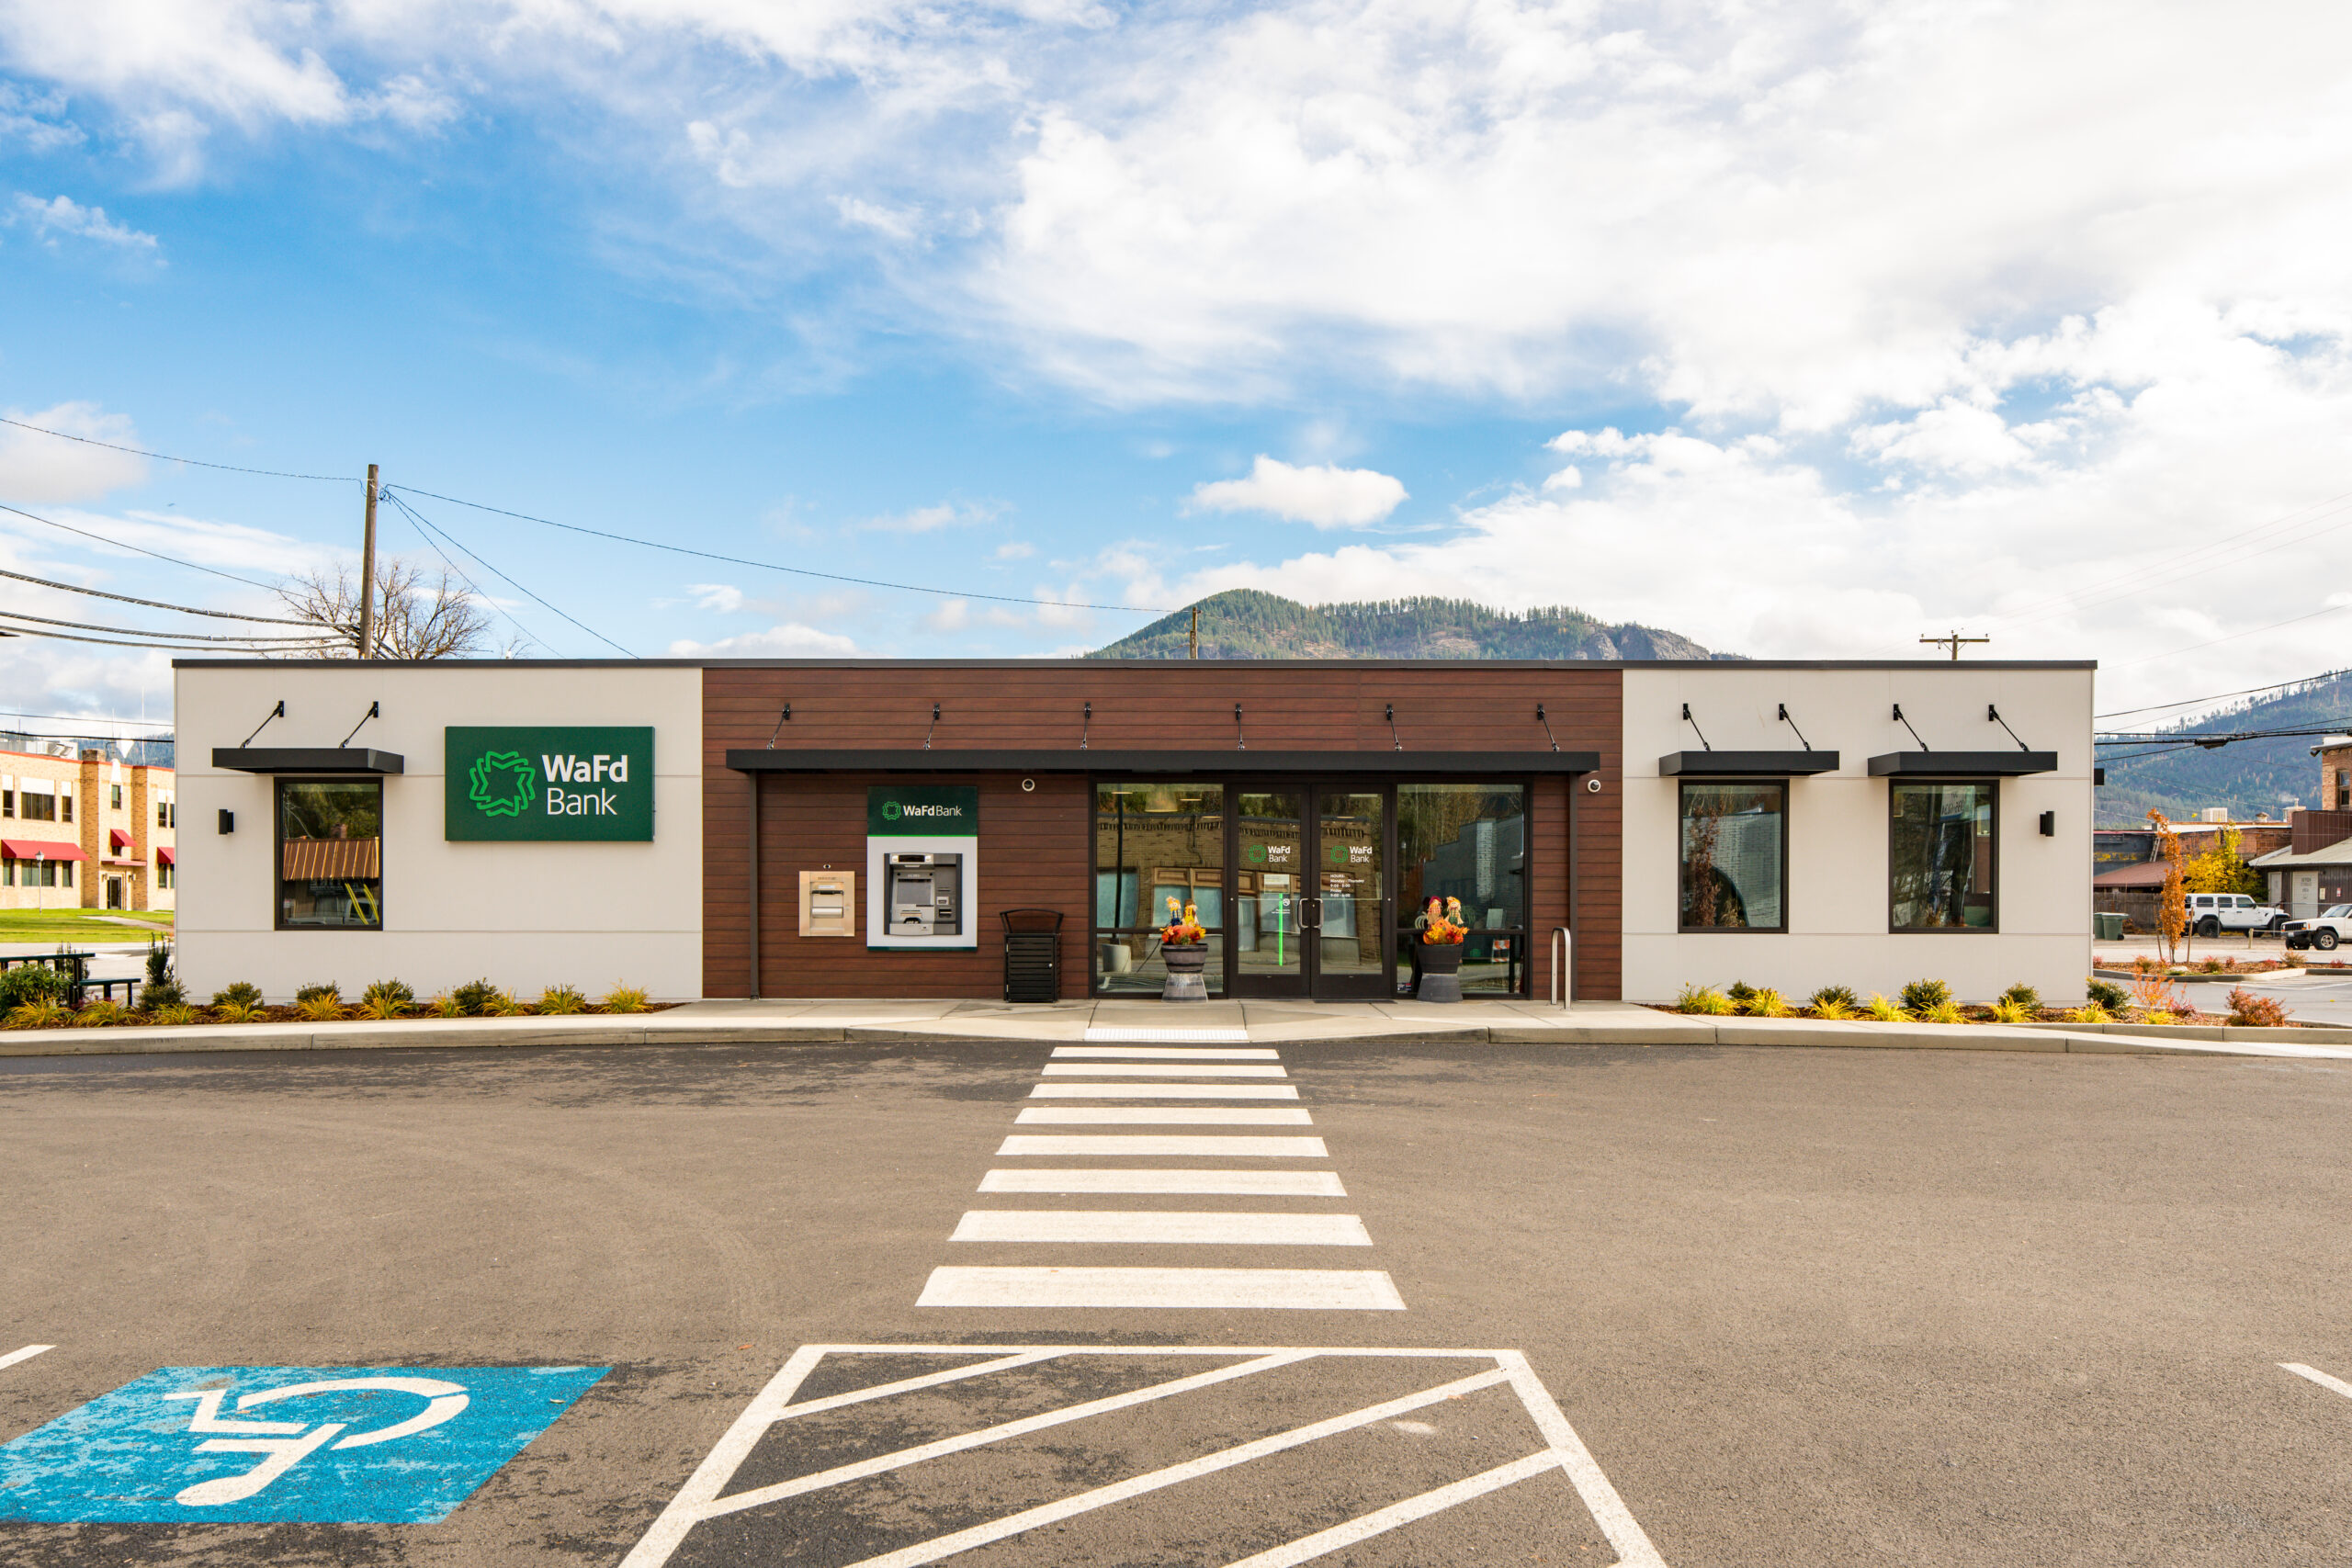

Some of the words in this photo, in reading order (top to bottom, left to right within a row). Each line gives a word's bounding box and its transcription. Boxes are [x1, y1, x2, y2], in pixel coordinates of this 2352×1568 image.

[541, 754, 628, 783] WaFd
[547, 787, 617, 816] Bank
[1268, 846, 1291, 854] WaFd
[1349, 846, 1373, 854] WaFd
[1269, 854, 1288, 863] Bank
[1351, 854, 1370, 863] Bank
